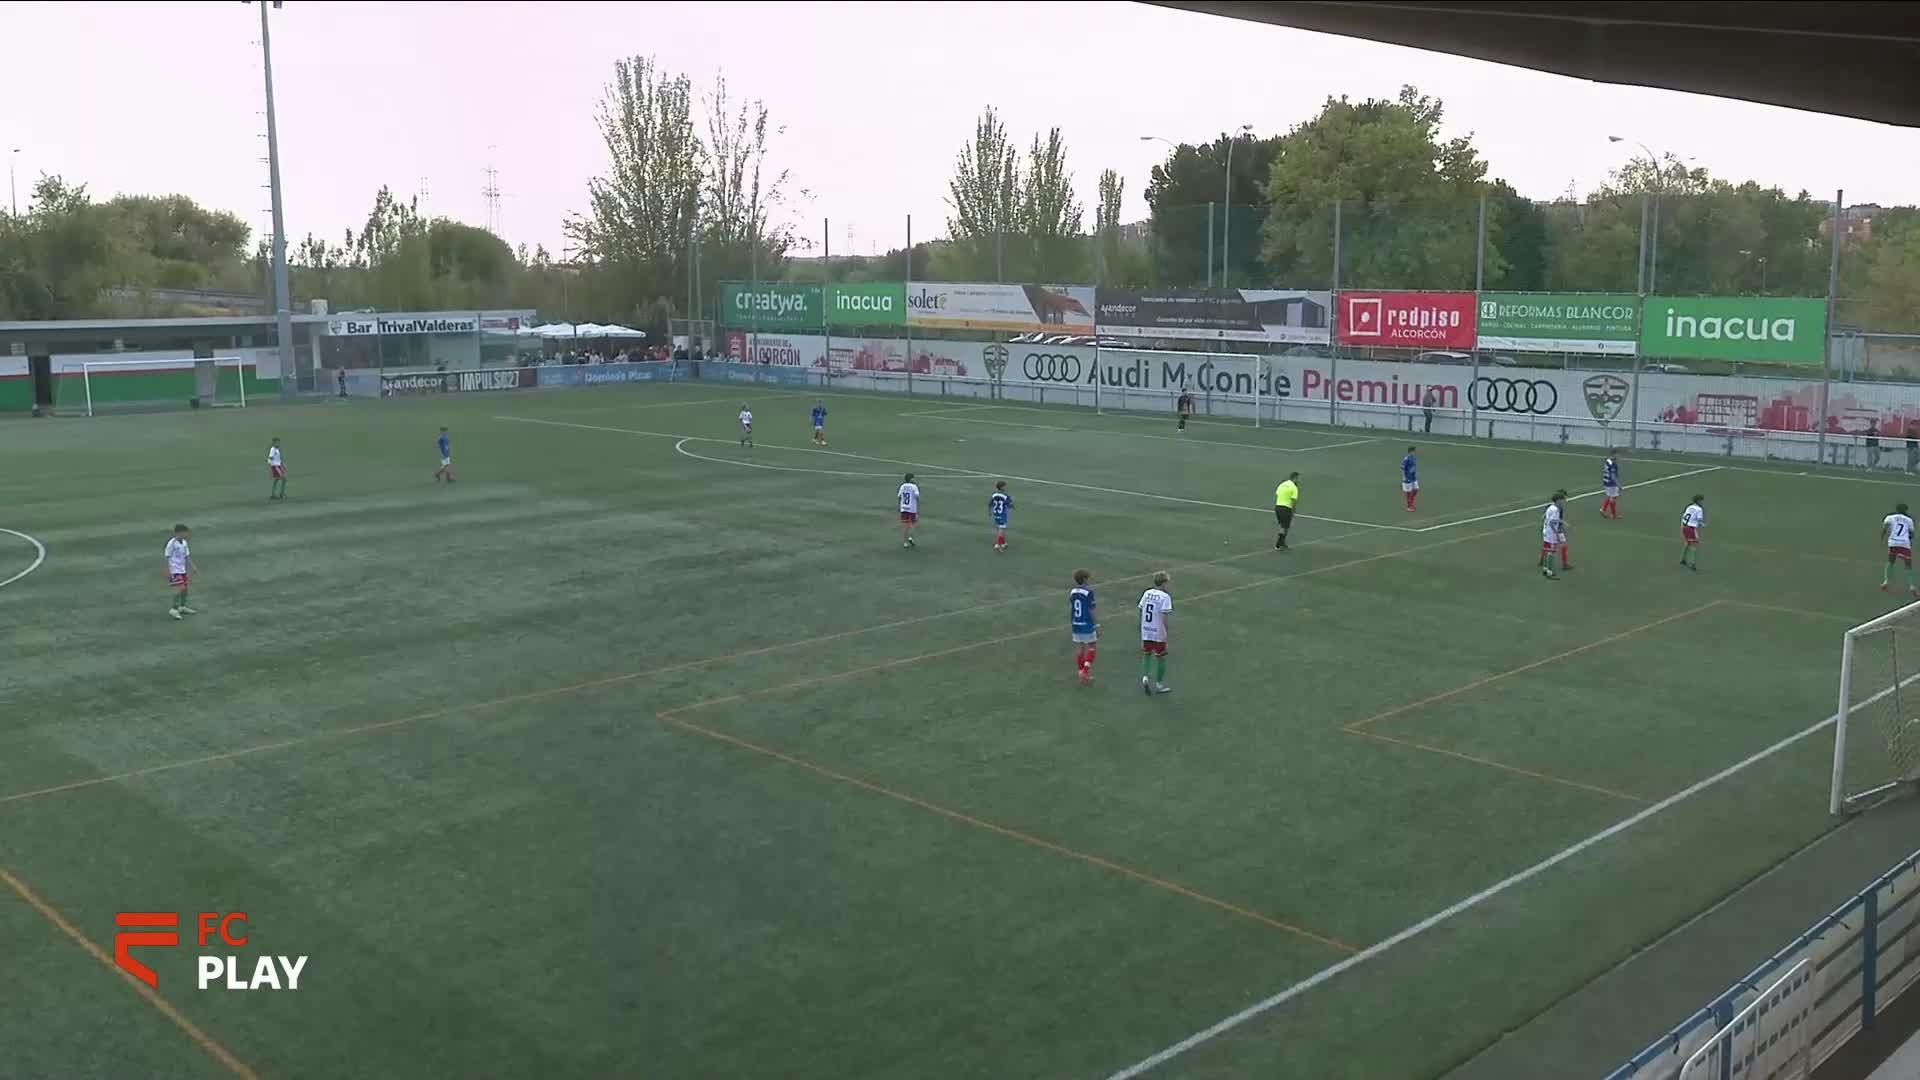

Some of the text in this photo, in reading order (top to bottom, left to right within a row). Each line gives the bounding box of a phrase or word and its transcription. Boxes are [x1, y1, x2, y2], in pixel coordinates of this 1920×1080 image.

[836, 290, 892, 312] inacua
[1387, 306, 1460, 328] redpiso
[1499, 304, 1633, 320] REFORMAS BLANCOR
[347, 322, 372, 334] Bar
[1391, 328, 1446, 339] ALCORCÓN
[1666, 307, 1795, 342] inacua
[1088, 360, 1149, 388] Audi
[1302, 369, 1459, 409] Premium
[992, 500, 1004, 514] 23
[1897, 523, 1904, 537] 7
[1074, 599, 1082, 618] 9
[1145, 603, 1154, 623] 5
